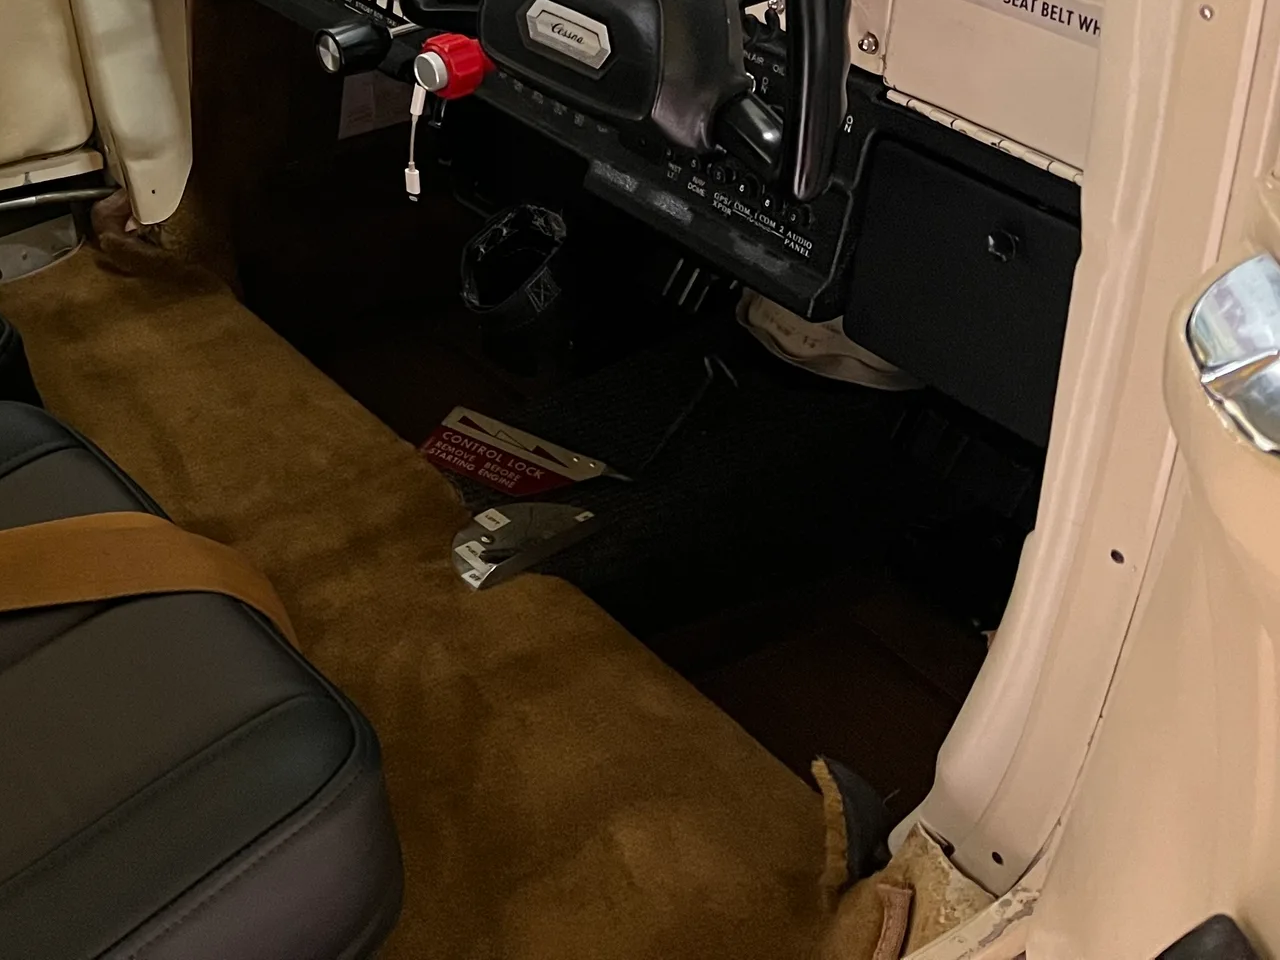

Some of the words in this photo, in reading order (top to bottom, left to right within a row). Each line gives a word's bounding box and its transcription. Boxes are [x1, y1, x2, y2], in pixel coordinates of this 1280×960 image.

[1041, 0, 1075, 26] BELT
[550, 22, 584, 44] Cessna
[712, 200, 732, 216] XPDR
[734, 202, 751, 216] COM
[759, 215, 776, 230] COM
[779, 225, 785, 234] 2
[784, 238, 811, 258] PANEL
[786, 230, 813, 250] AUDIO
[435, 441, 476, 462] REMOVE
[483, 461, 521, 481] BEFORE
[442, 431, 503, 463] CONTROL
[507, 459, 545, 479] LOCK
[429, 447, 476, 471] STARTING
[478, 468, 517, 488] ENGINE
